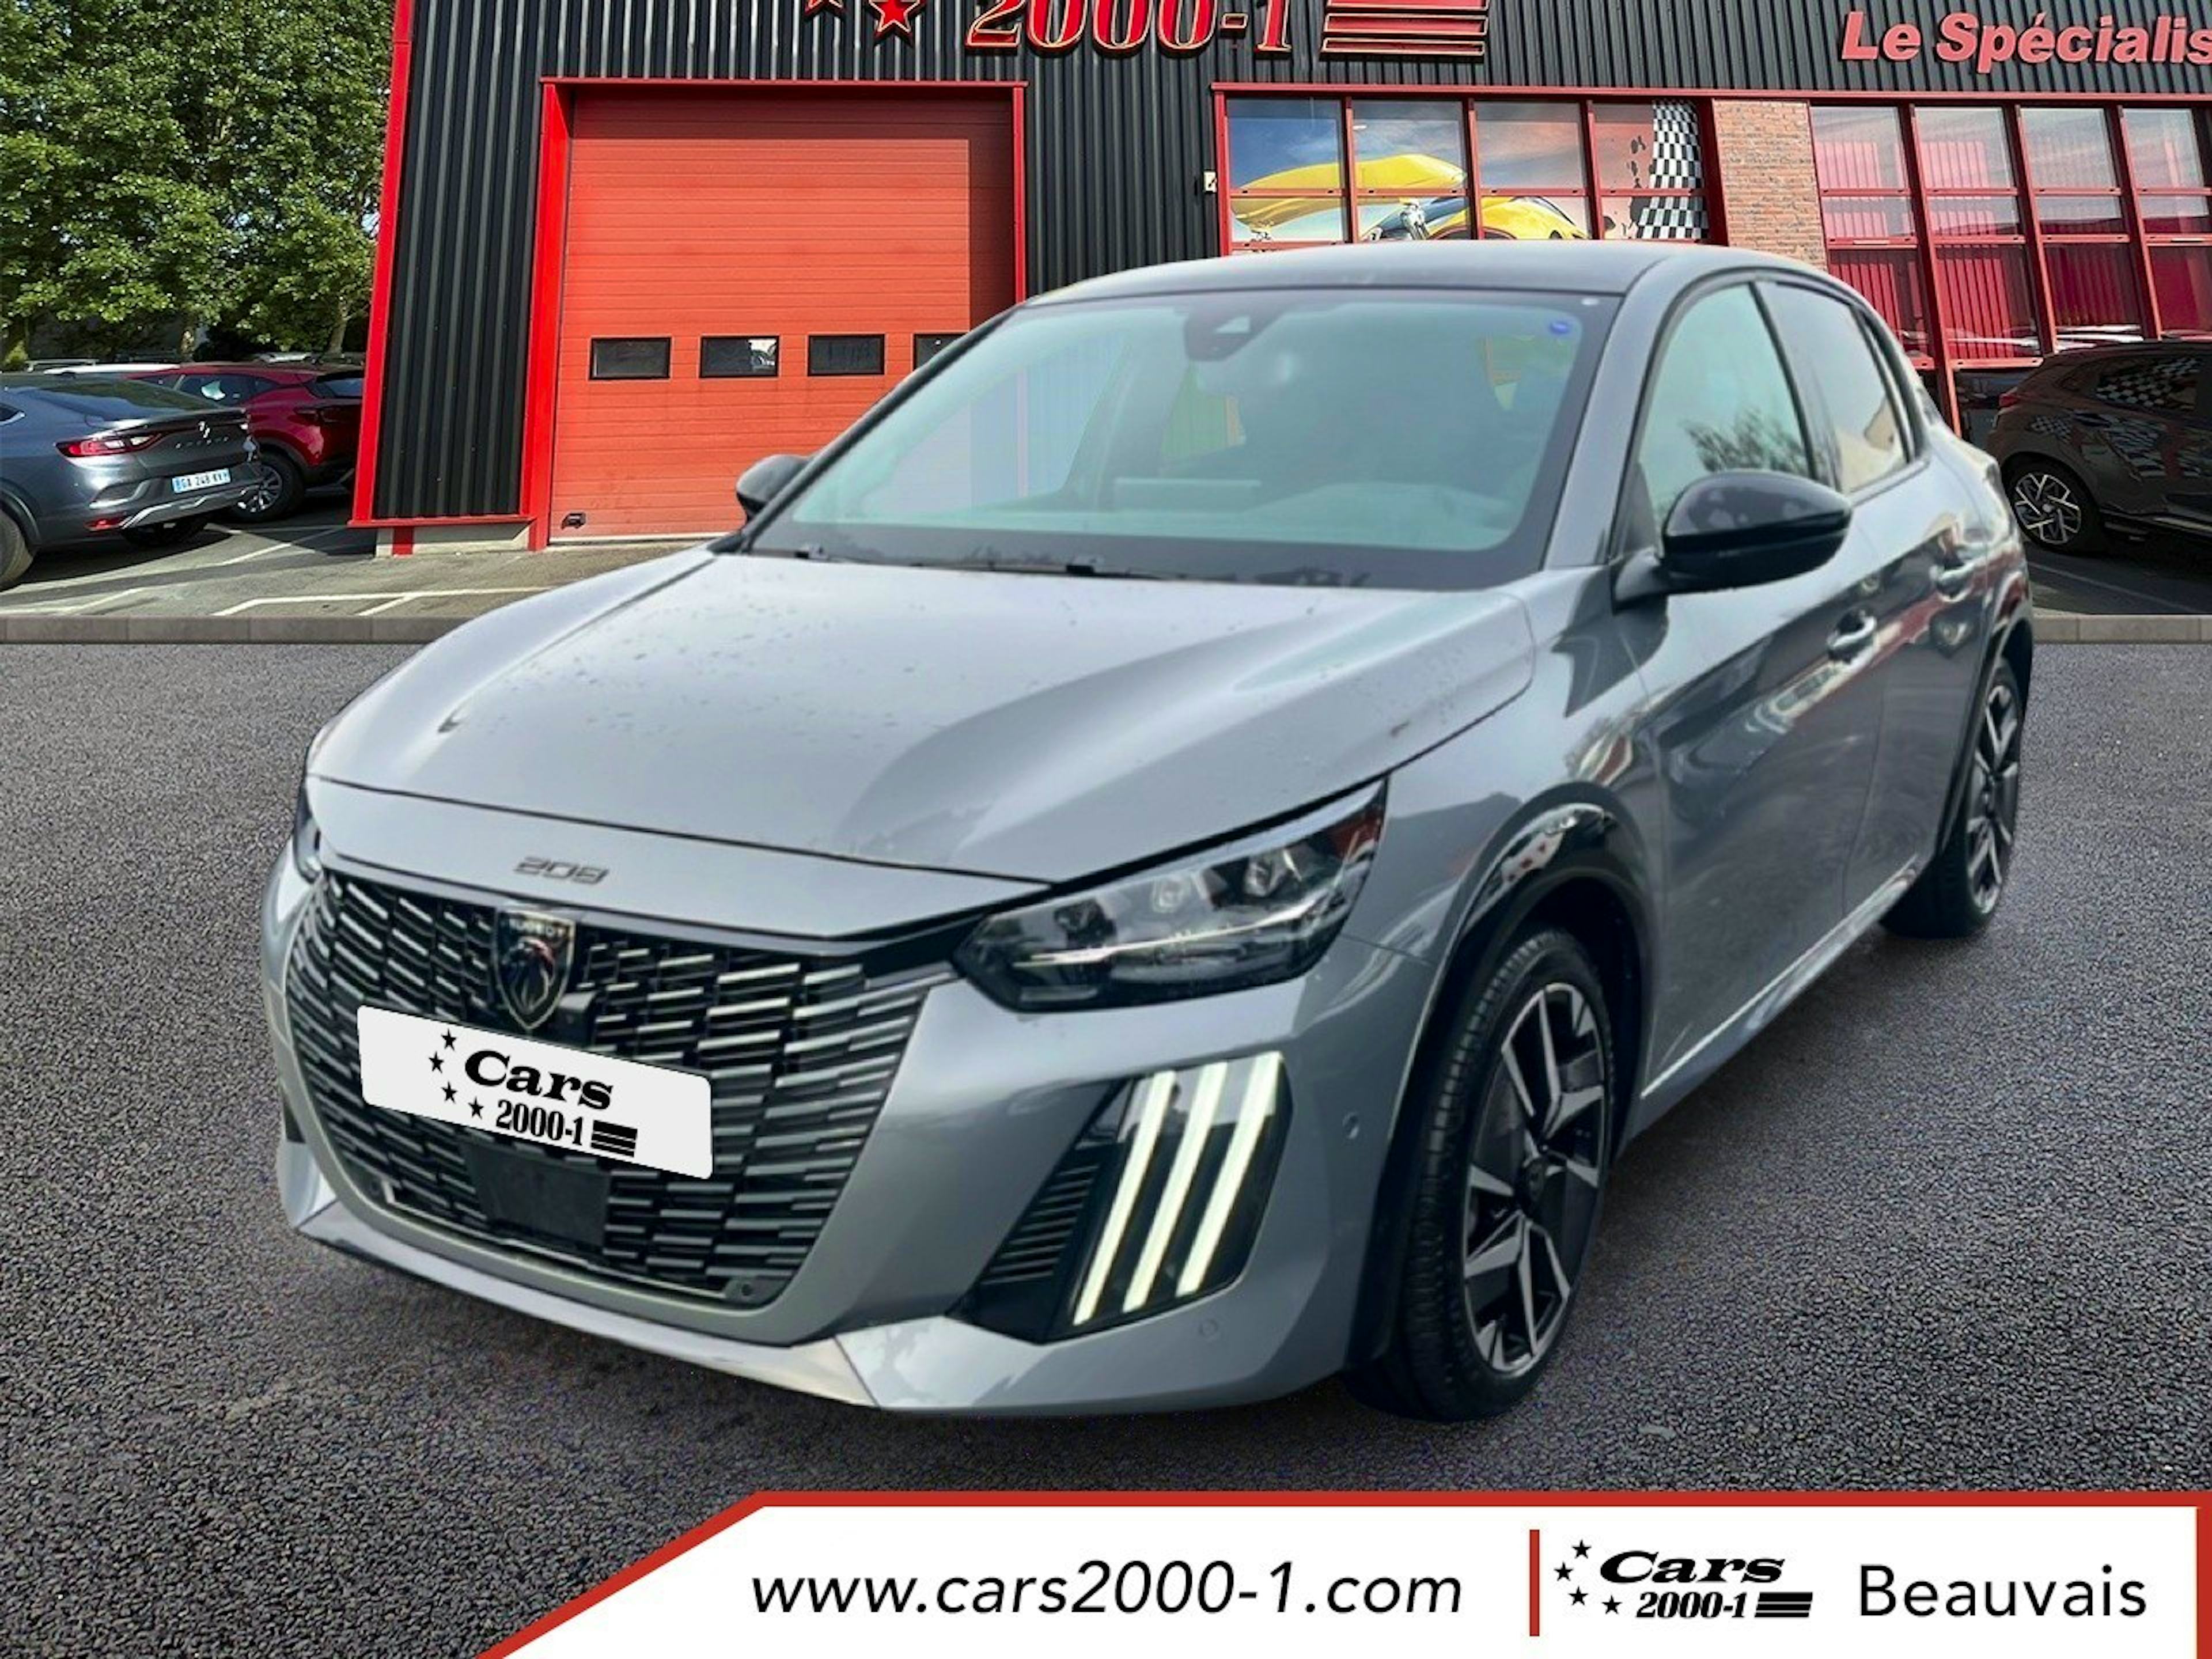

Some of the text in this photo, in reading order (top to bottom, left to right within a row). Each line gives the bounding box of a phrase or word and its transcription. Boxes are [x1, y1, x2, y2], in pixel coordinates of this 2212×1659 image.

[1843, 11, 2212, 73] Le Spécialis
[513, 856, 608, 884] 208
